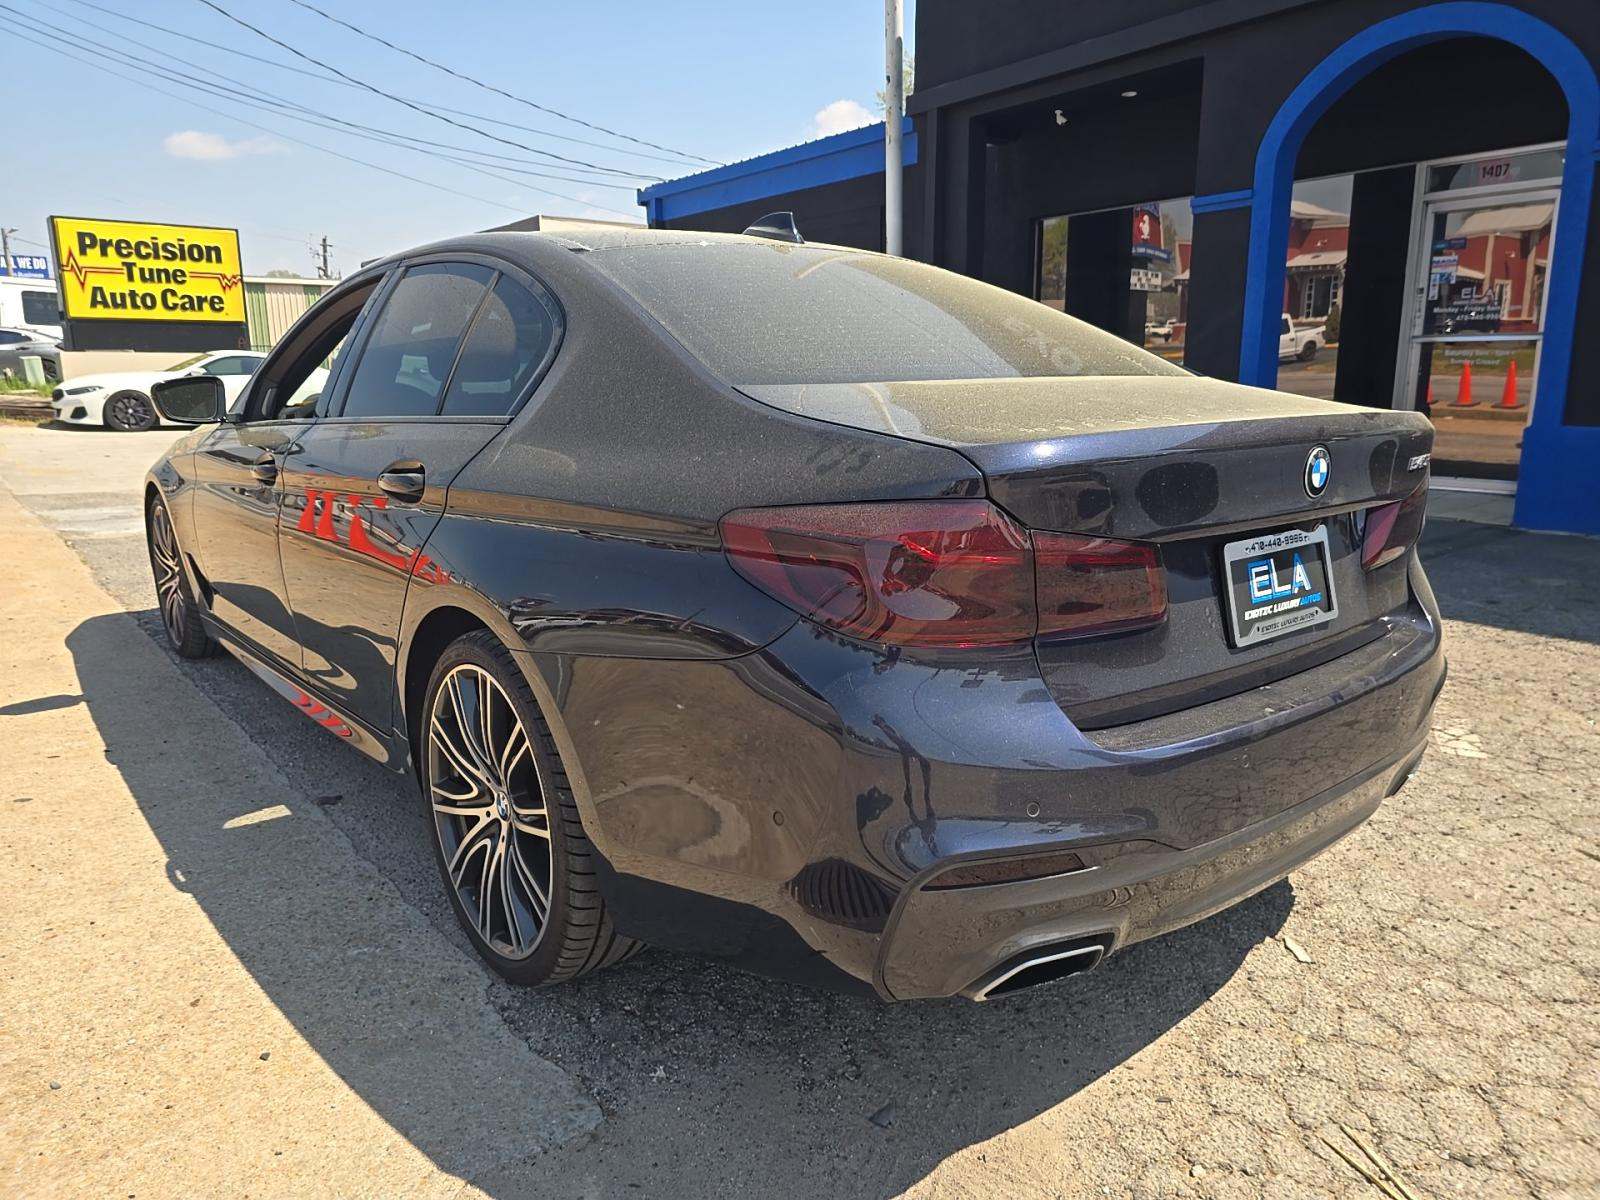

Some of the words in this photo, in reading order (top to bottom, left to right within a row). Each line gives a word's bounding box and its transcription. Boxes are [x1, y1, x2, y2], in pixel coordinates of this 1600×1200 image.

[1482, 163, 1510, 179] 1407
[76, 231, 223, 264] Precision
[17, 256, 32, 269] WE
[33, 257, 47, 270] DO
[121, 262, 187, 285] Tune
[90, 286, 158, 311] Auto
[161, 288, 225, 313] Care
[1248, 552, 1312, 604] ELA
